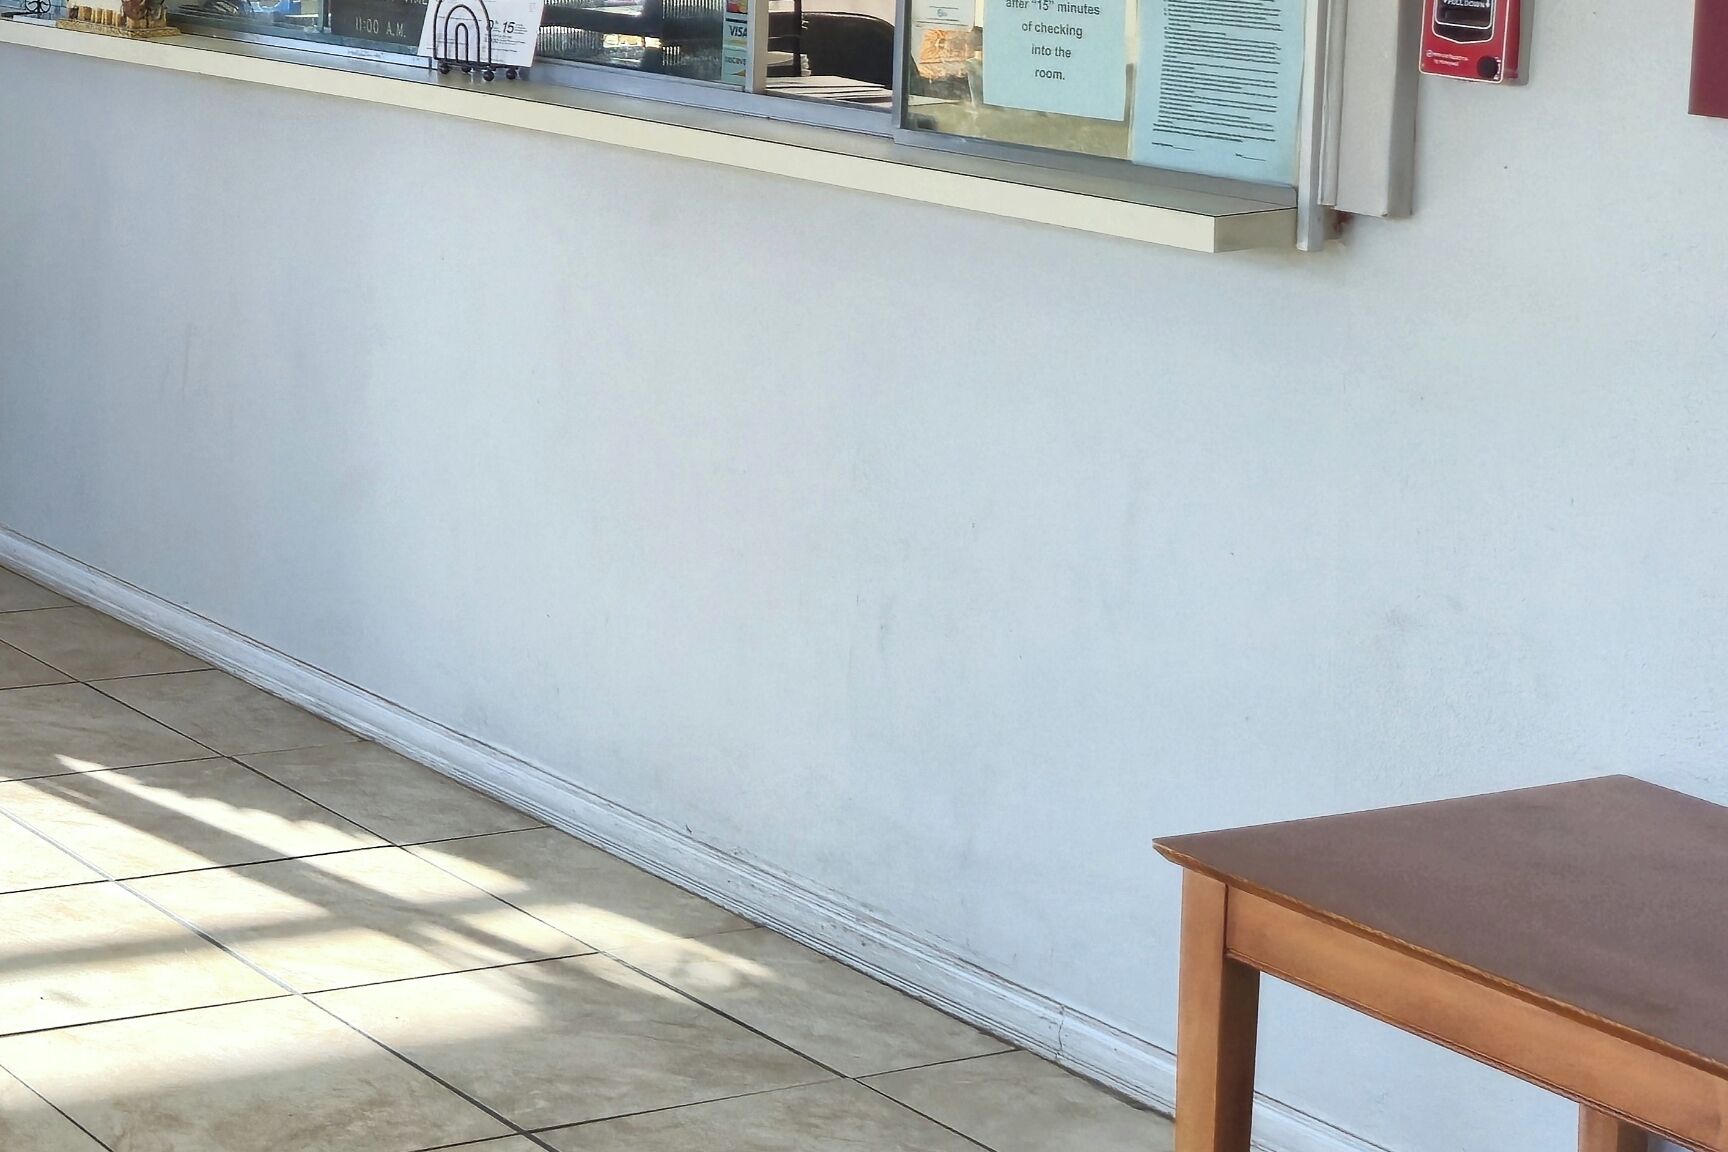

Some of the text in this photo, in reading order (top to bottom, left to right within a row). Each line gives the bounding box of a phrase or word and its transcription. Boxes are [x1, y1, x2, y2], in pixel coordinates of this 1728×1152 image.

[1057, 1, 1100, 15] minutes
[355, 17, 406, 38] 11:00 A.M.
[729, 26, 747, 37] VISA
[1021, 21, 1083, 39] of checking
[1031, 43, 1071, 58] into the
[1035, 68, 1065, 80] room.
